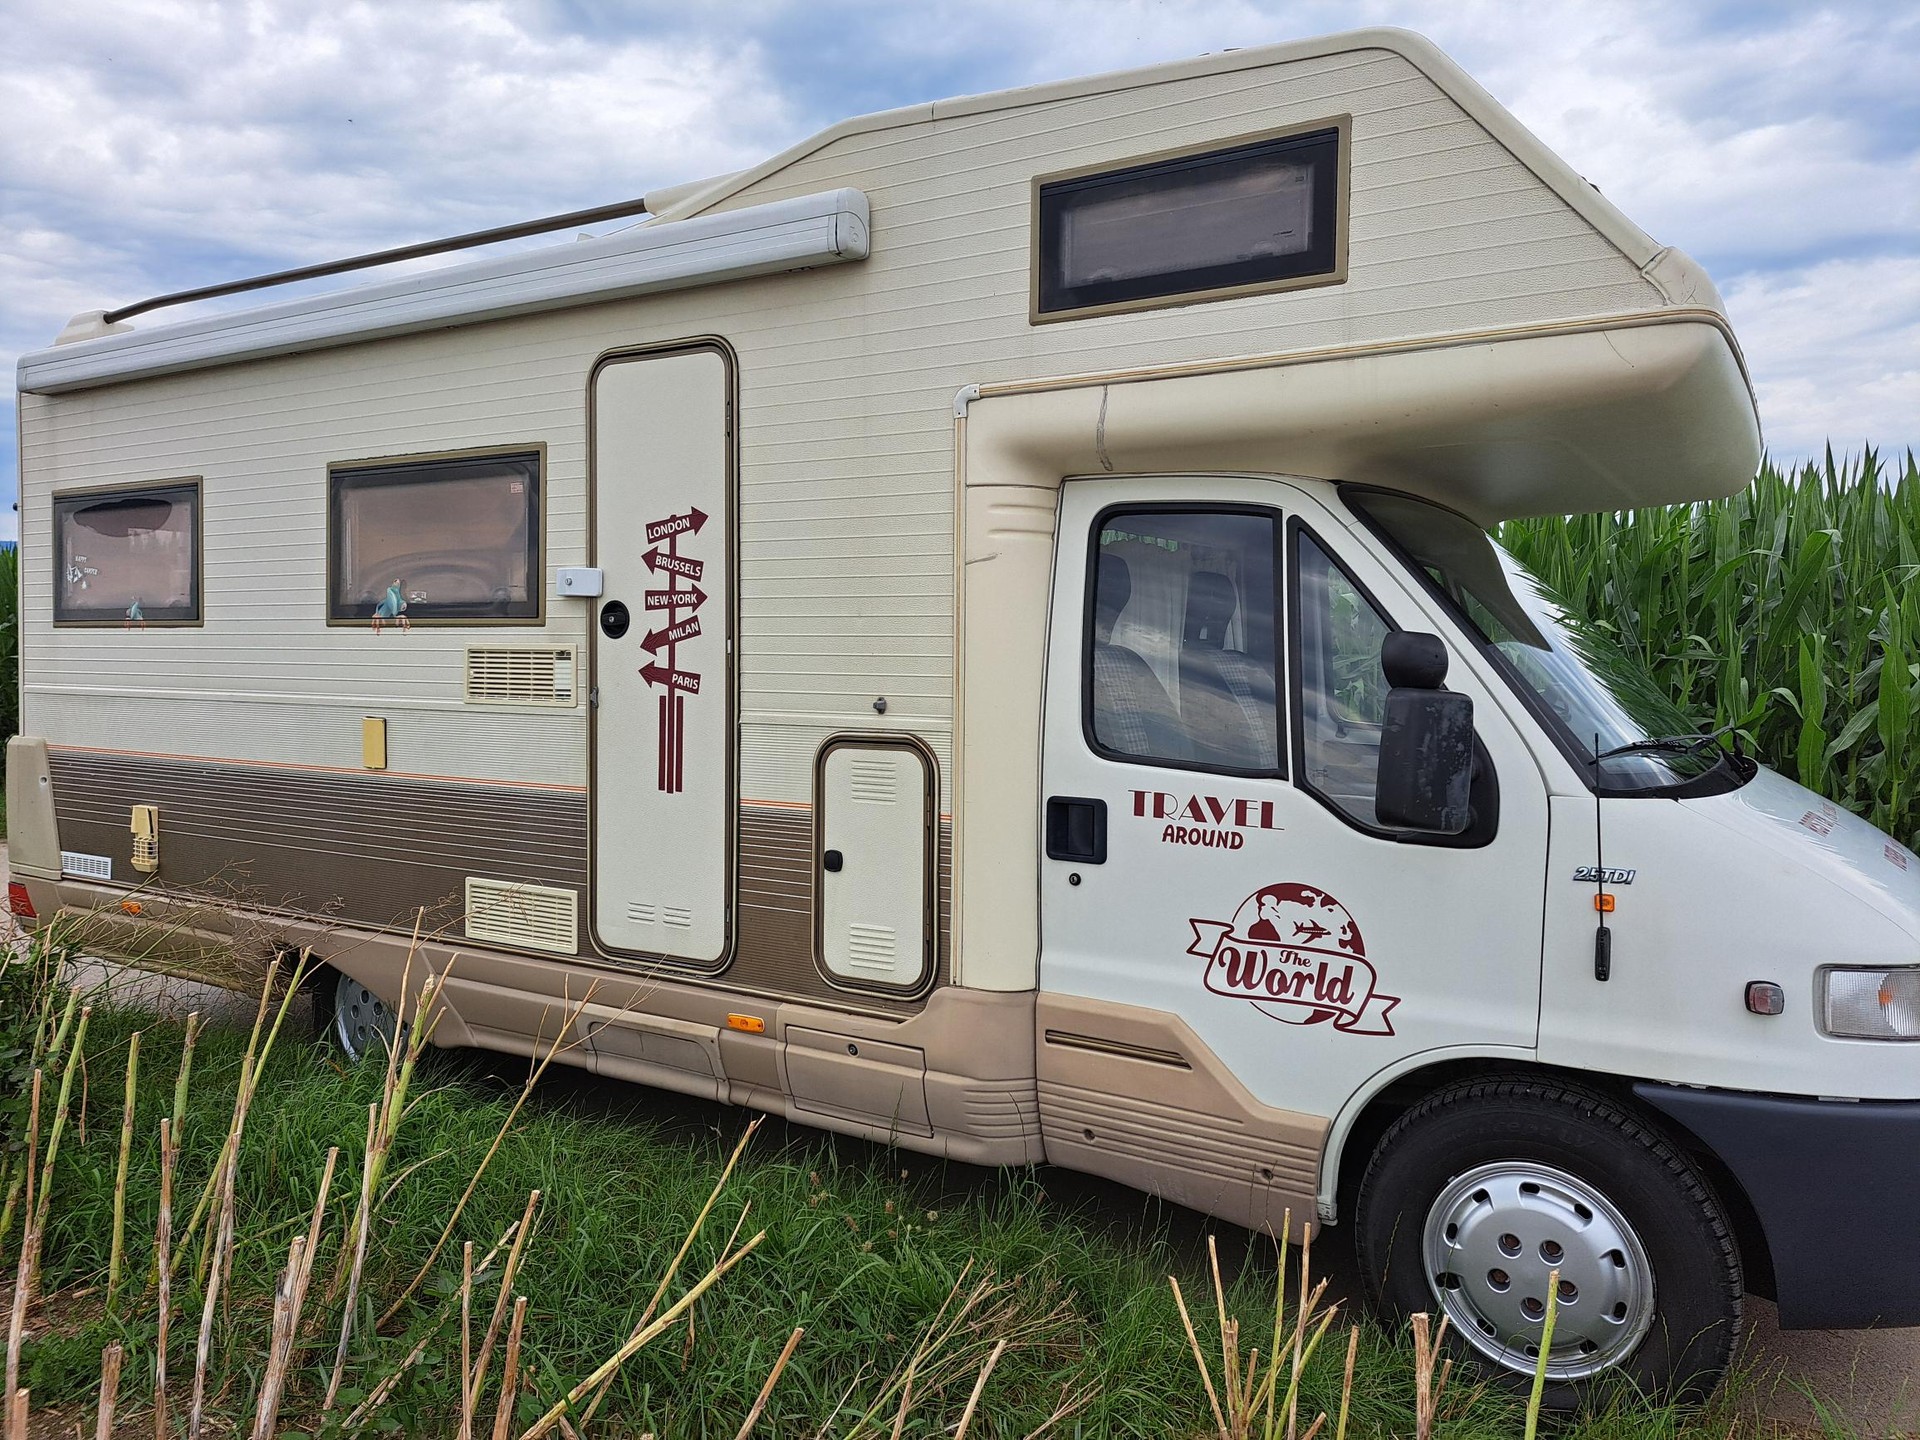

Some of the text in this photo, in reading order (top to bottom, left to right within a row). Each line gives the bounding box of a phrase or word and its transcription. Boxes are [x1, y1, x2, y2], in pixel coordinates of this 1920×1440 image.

[648, 517, 690, 539] LONDON
[655, 555, 701, 576] BRUSSELS
[647, 593, 697, 606] NEW-YORK
[668, 622, 699, 641] MILAN
[671, 673, 699, 690] PARIS
[1128, 789, 1285, 830] TRAVEL
[1161, 824, 1244, 850] AROUND
[1279, 949, 1312, 968] The
[1218, 947, 1355, 1004] World
